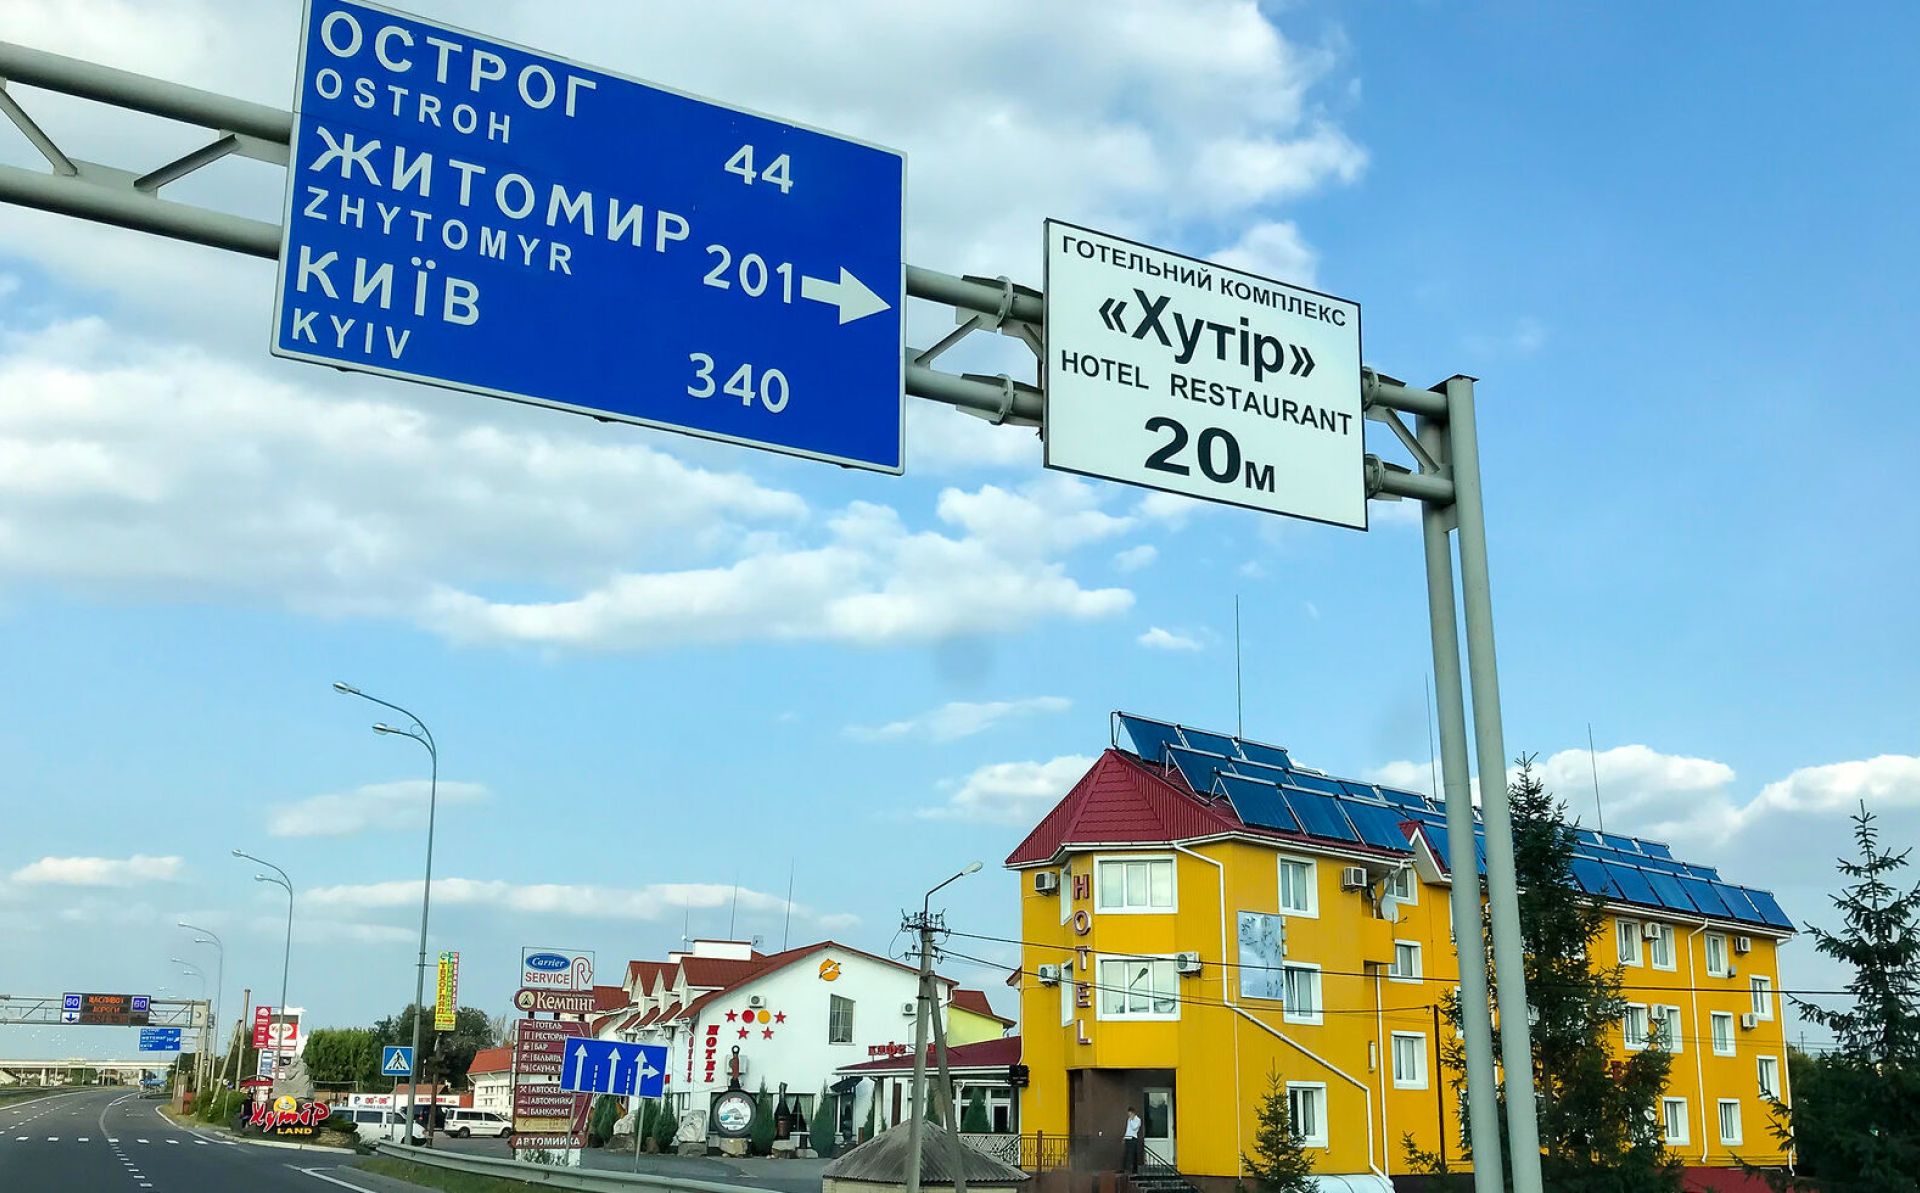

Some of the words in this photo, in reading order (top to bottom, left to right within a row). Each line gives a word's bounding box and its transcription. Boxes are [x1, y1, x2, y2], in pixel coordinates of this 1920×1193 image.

[321, 11, 597, 118] ОСТРОГ
[315, 68, 511, 144] OSTROH
[308, 126, 690, 253] ЖИТОМИР
[724, 144, 794, 194] 44
[303, 186, 573, 276] ZHYTOMYR
[296, 245, 480, 326] КИЇВ
[703, 244, 793, 304] 201
[1063, 235, 1212, 292] ГОТЕЛЬНИЙ
[1220, 278, 1346, 327] КОМПЛЕКС
[291, 308, 411, 360] KYIV
[1098, 288, 1316, 383] «Хутір»
[687, 352, 790, 413] 340
[1062, 350, 1149, 390] HOTEL
[1170, 373, 1352, 435] RESTAURANT
[525, 972, 570, 984] SERVICE
[531, 957, 566, 967] Carrier
[1073, 874, 1092, 1045] HOTEL
[535, 1022, 562, 1030] ГОТЕЛЬ
[535, 1043, 549, 1051] БАР
[704, 1025, 720, 1082] HOTEL
[531, 1085, 571, 1094] АВТОСЕ
[532, 1064, 556, 1072] САУНА
[277, 1127, 313, 1135] LAND
[530, 1108, 569, 1116] БАНКОМАТ
